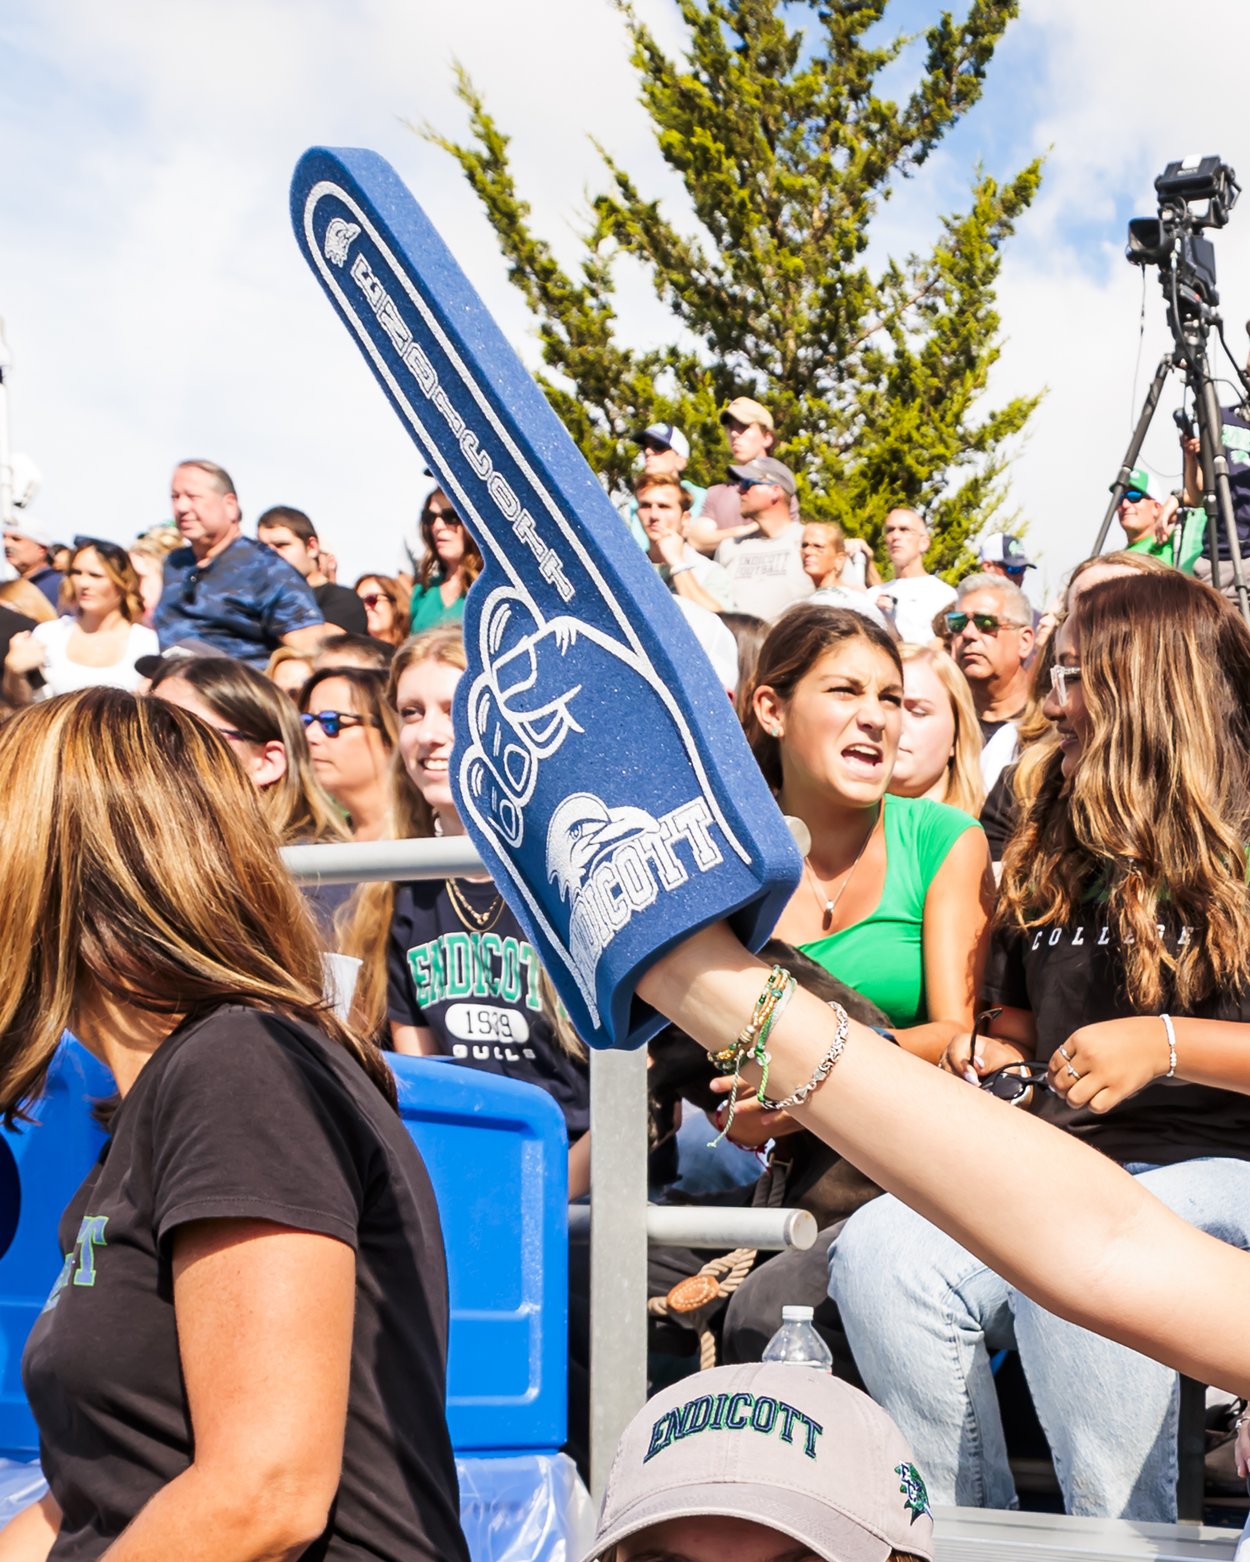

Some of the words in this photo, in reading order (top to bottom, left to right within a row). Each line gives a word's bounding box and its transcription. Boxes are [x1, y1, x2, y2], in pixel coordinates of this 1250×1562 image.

[350, 251, 577, 603] ENDICOTT
[406, 931, 544, 1014] ENDICOT
[643, 1392, 824, 1465] ENDICOTT
